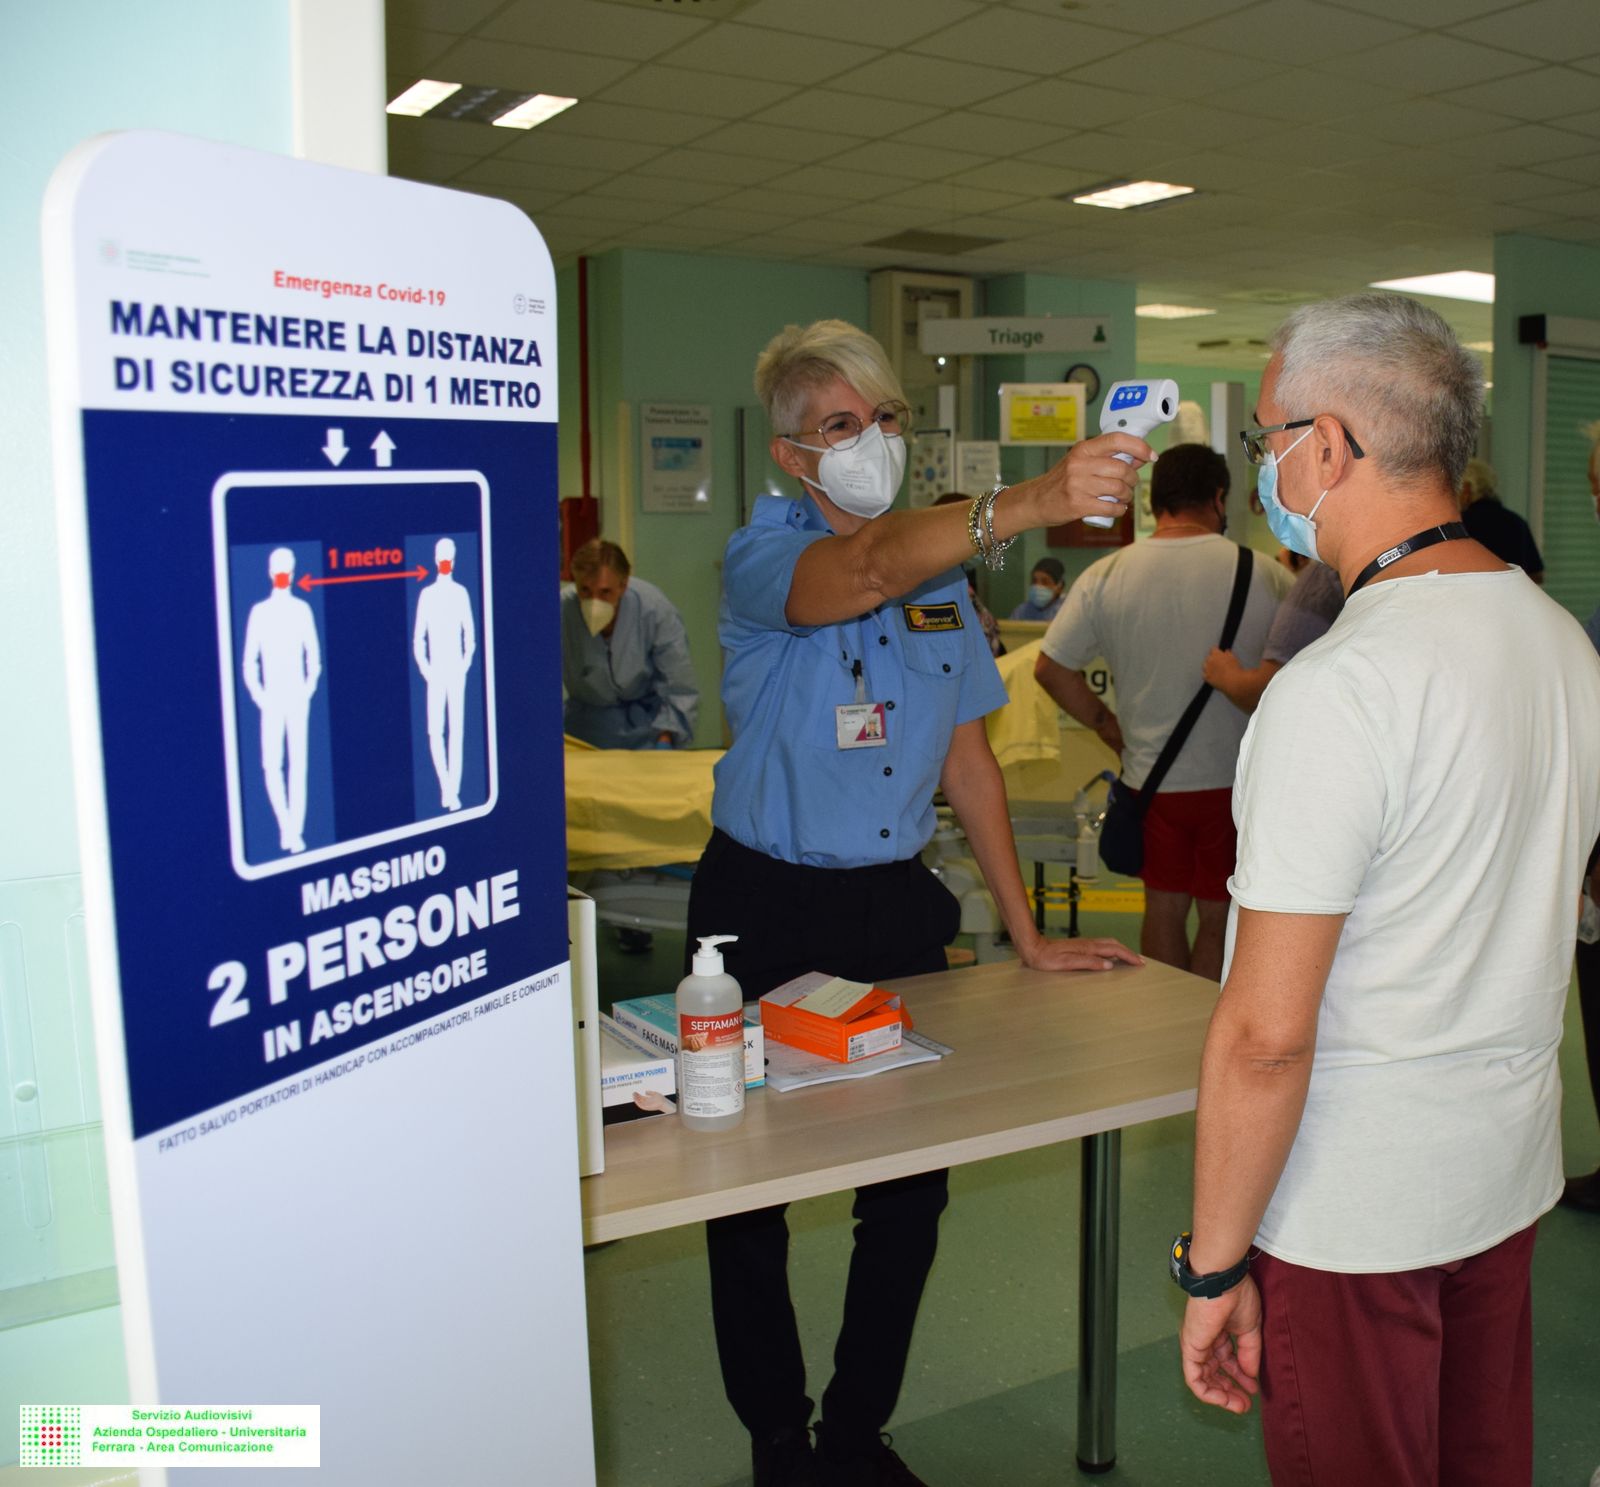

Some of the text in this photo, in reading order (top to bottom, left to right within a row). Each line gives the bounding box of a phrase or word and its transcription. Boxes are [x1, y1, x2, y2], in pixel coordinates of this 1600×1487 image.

[273, 270, 446, 307] Emergenza Covid-19
[110, 299, 543, 368] MANTENERE LA DISTANZA
[988, 328, 1044, 349] Triage
[114, 356, 542, 409] DI SICUREZZA DI 1 METRO
[328, 547, 403, 570] 1 metro
[301, 845, 446, 916] MASSIMO
[207, 869, 521, 1028] 2 PERSONE
[262, 949, 489, 1063] IN ASCENSORE
[691, 1016, 739, 1031] SEPTAMAN
[158, 973, 560, 1154] FATTO SALVO PORTATORI DI HANDICAP CON ACCOMPAGNATORI, FAMIGLIE E CONGIUNTI
[642, 1028, 659, 1047] FACE
